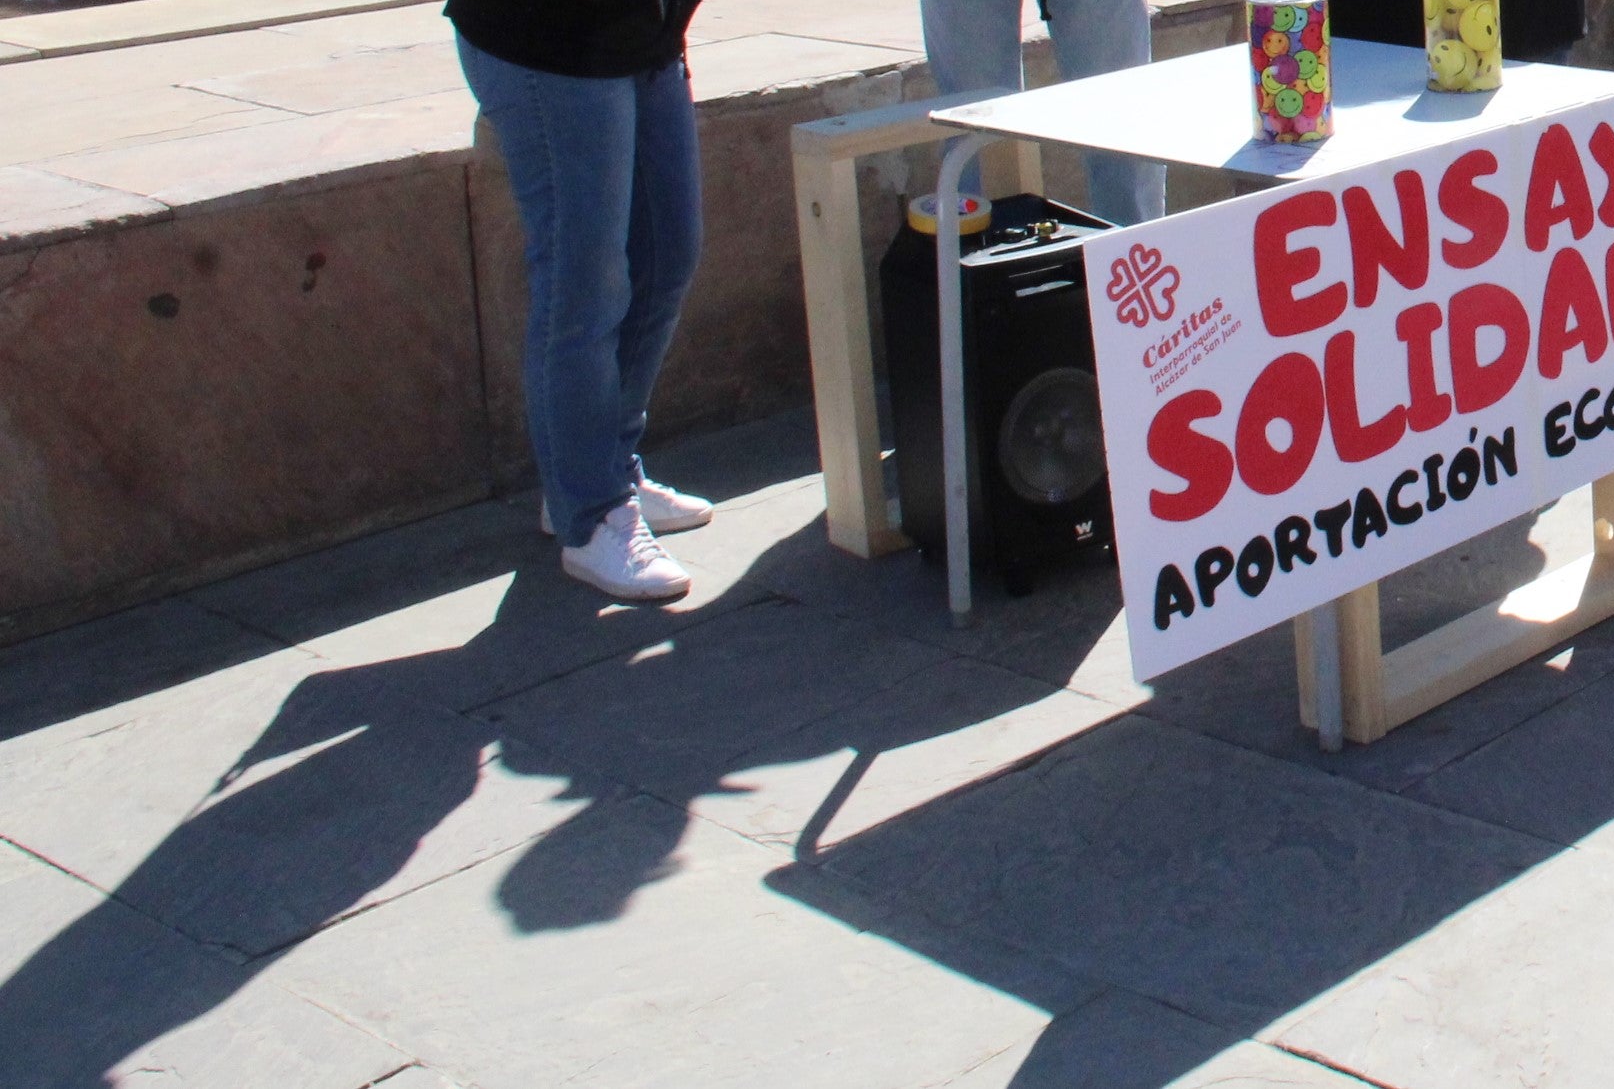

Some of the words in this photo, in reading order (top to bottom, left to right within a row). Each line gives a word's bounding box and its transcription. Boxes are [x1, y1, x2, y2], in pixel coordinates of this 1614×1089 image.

[1143, 297, 1223, 368] Cáritas
[1150, 321, 1219, 384] Interparroquial
[1220, 313, 1232, 326] de
[1191, 353, 1202, 365] de
[1203, 338, 1220, 355] San
[1221, 320, 1242, 343] Juan
[1155, 427, 1517, 630] APORTACIÓN
